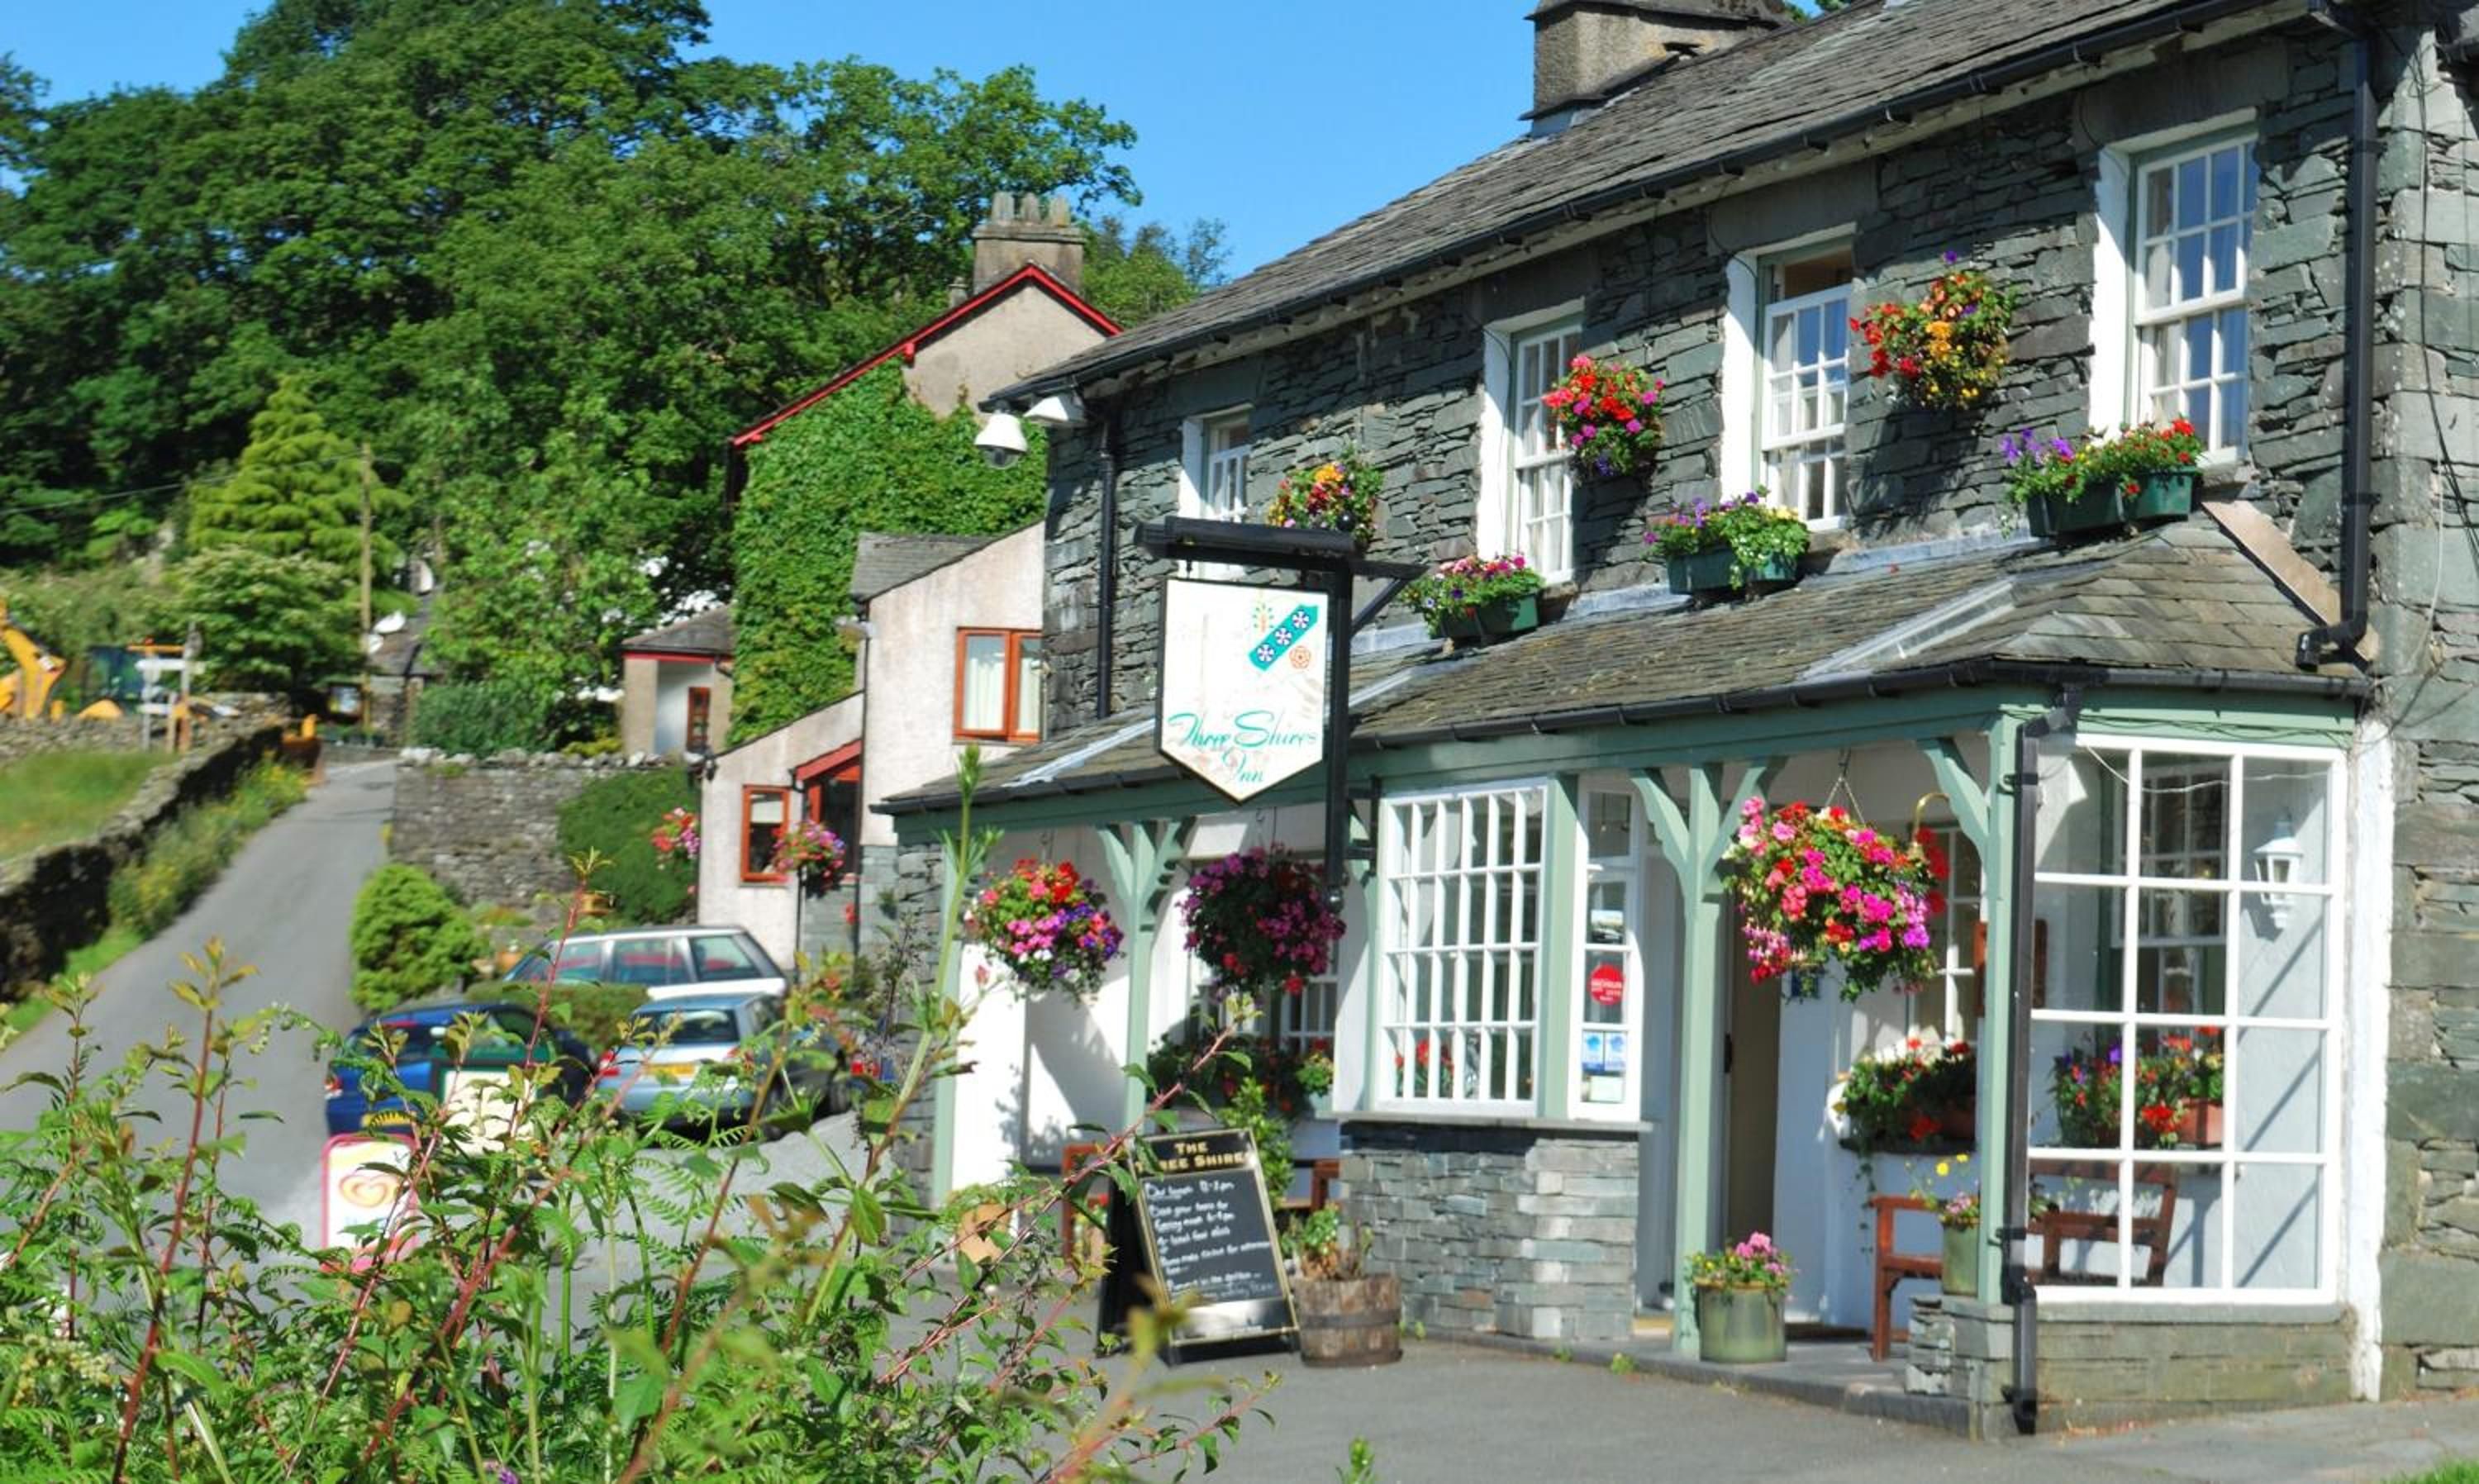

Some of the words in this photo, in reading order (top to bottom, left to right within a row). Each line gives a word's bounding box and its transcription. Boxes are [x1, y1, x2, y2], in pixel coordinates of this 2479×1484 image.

[1166, 712, 1231, 747] Three
[1233, 710, 1319, 748] Shires
[1221, 746, 1264, 783] Inn
[1174, 1141, 1208, 1155] THE
[1135, 1157, 1189, 1172] TREE
